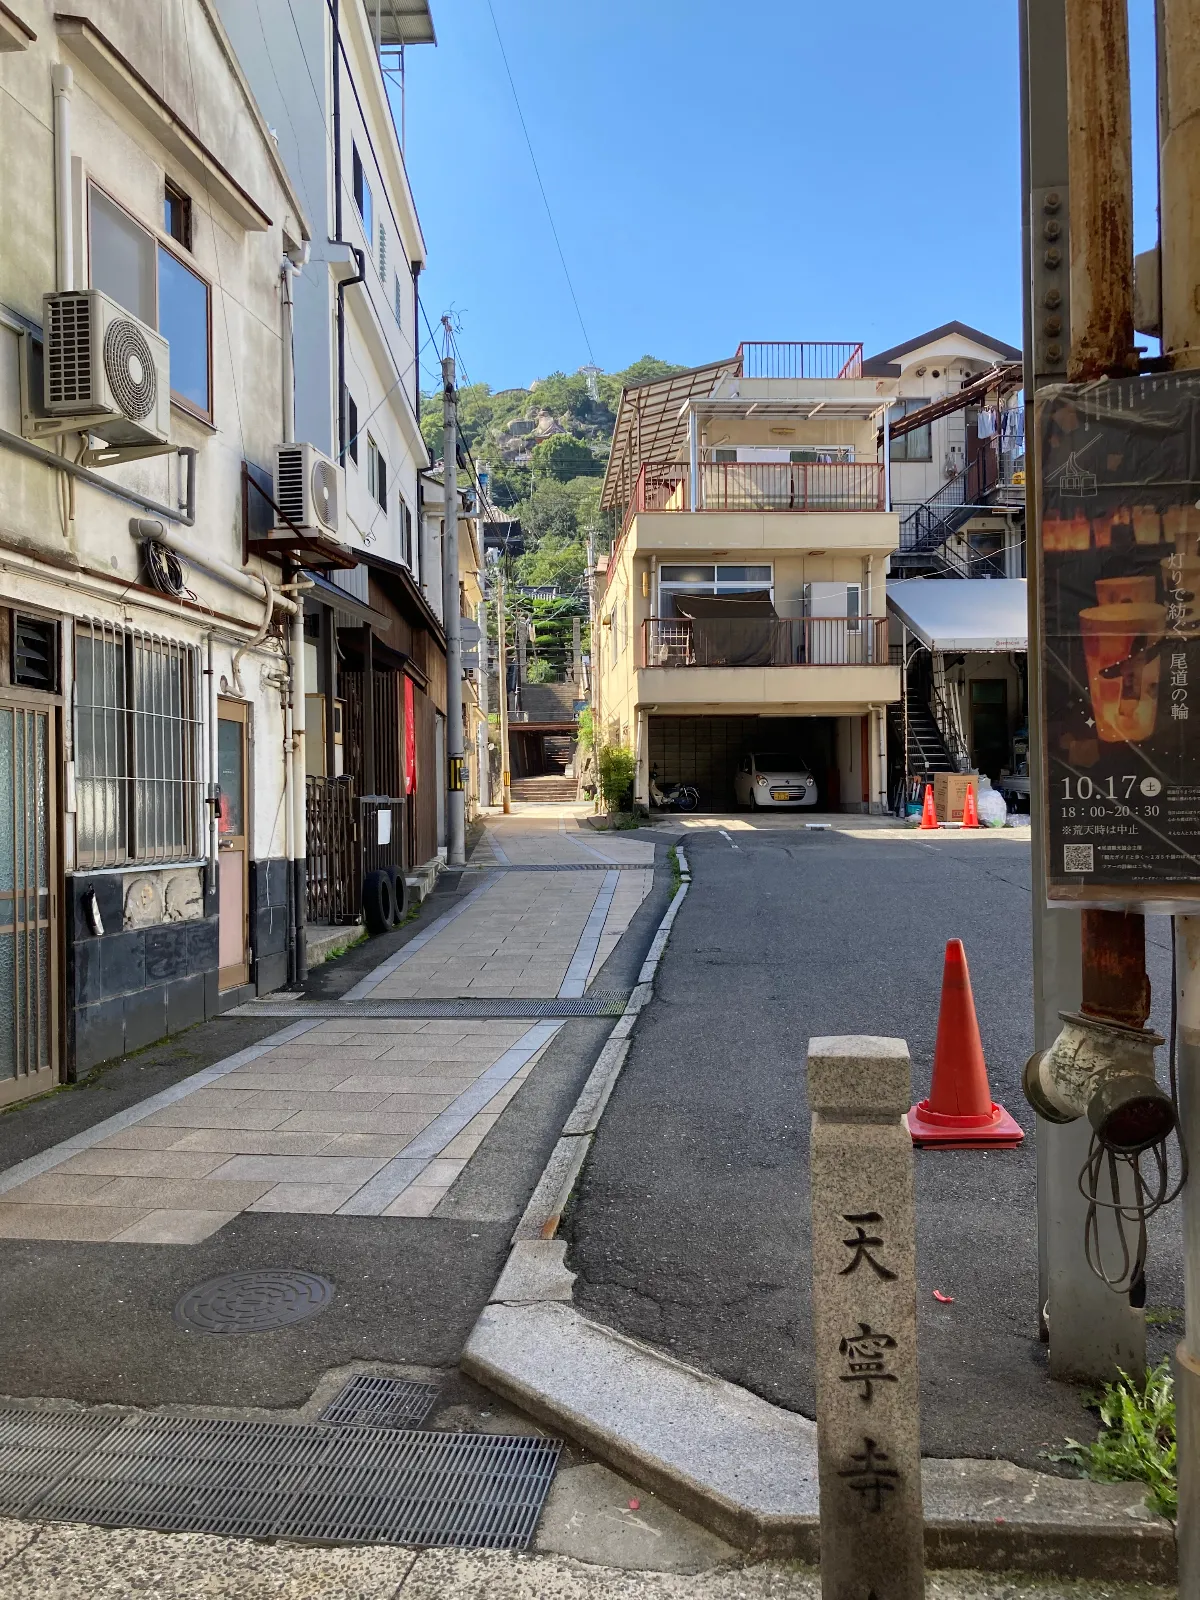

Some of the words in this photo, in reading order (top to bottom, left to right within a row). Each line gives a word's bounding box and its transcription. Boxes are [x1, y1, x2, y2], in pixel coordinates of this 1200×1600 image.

[1060, 775, 1138, 801] 10.17
[838, 1211, 899, 1513] 天寧寺
